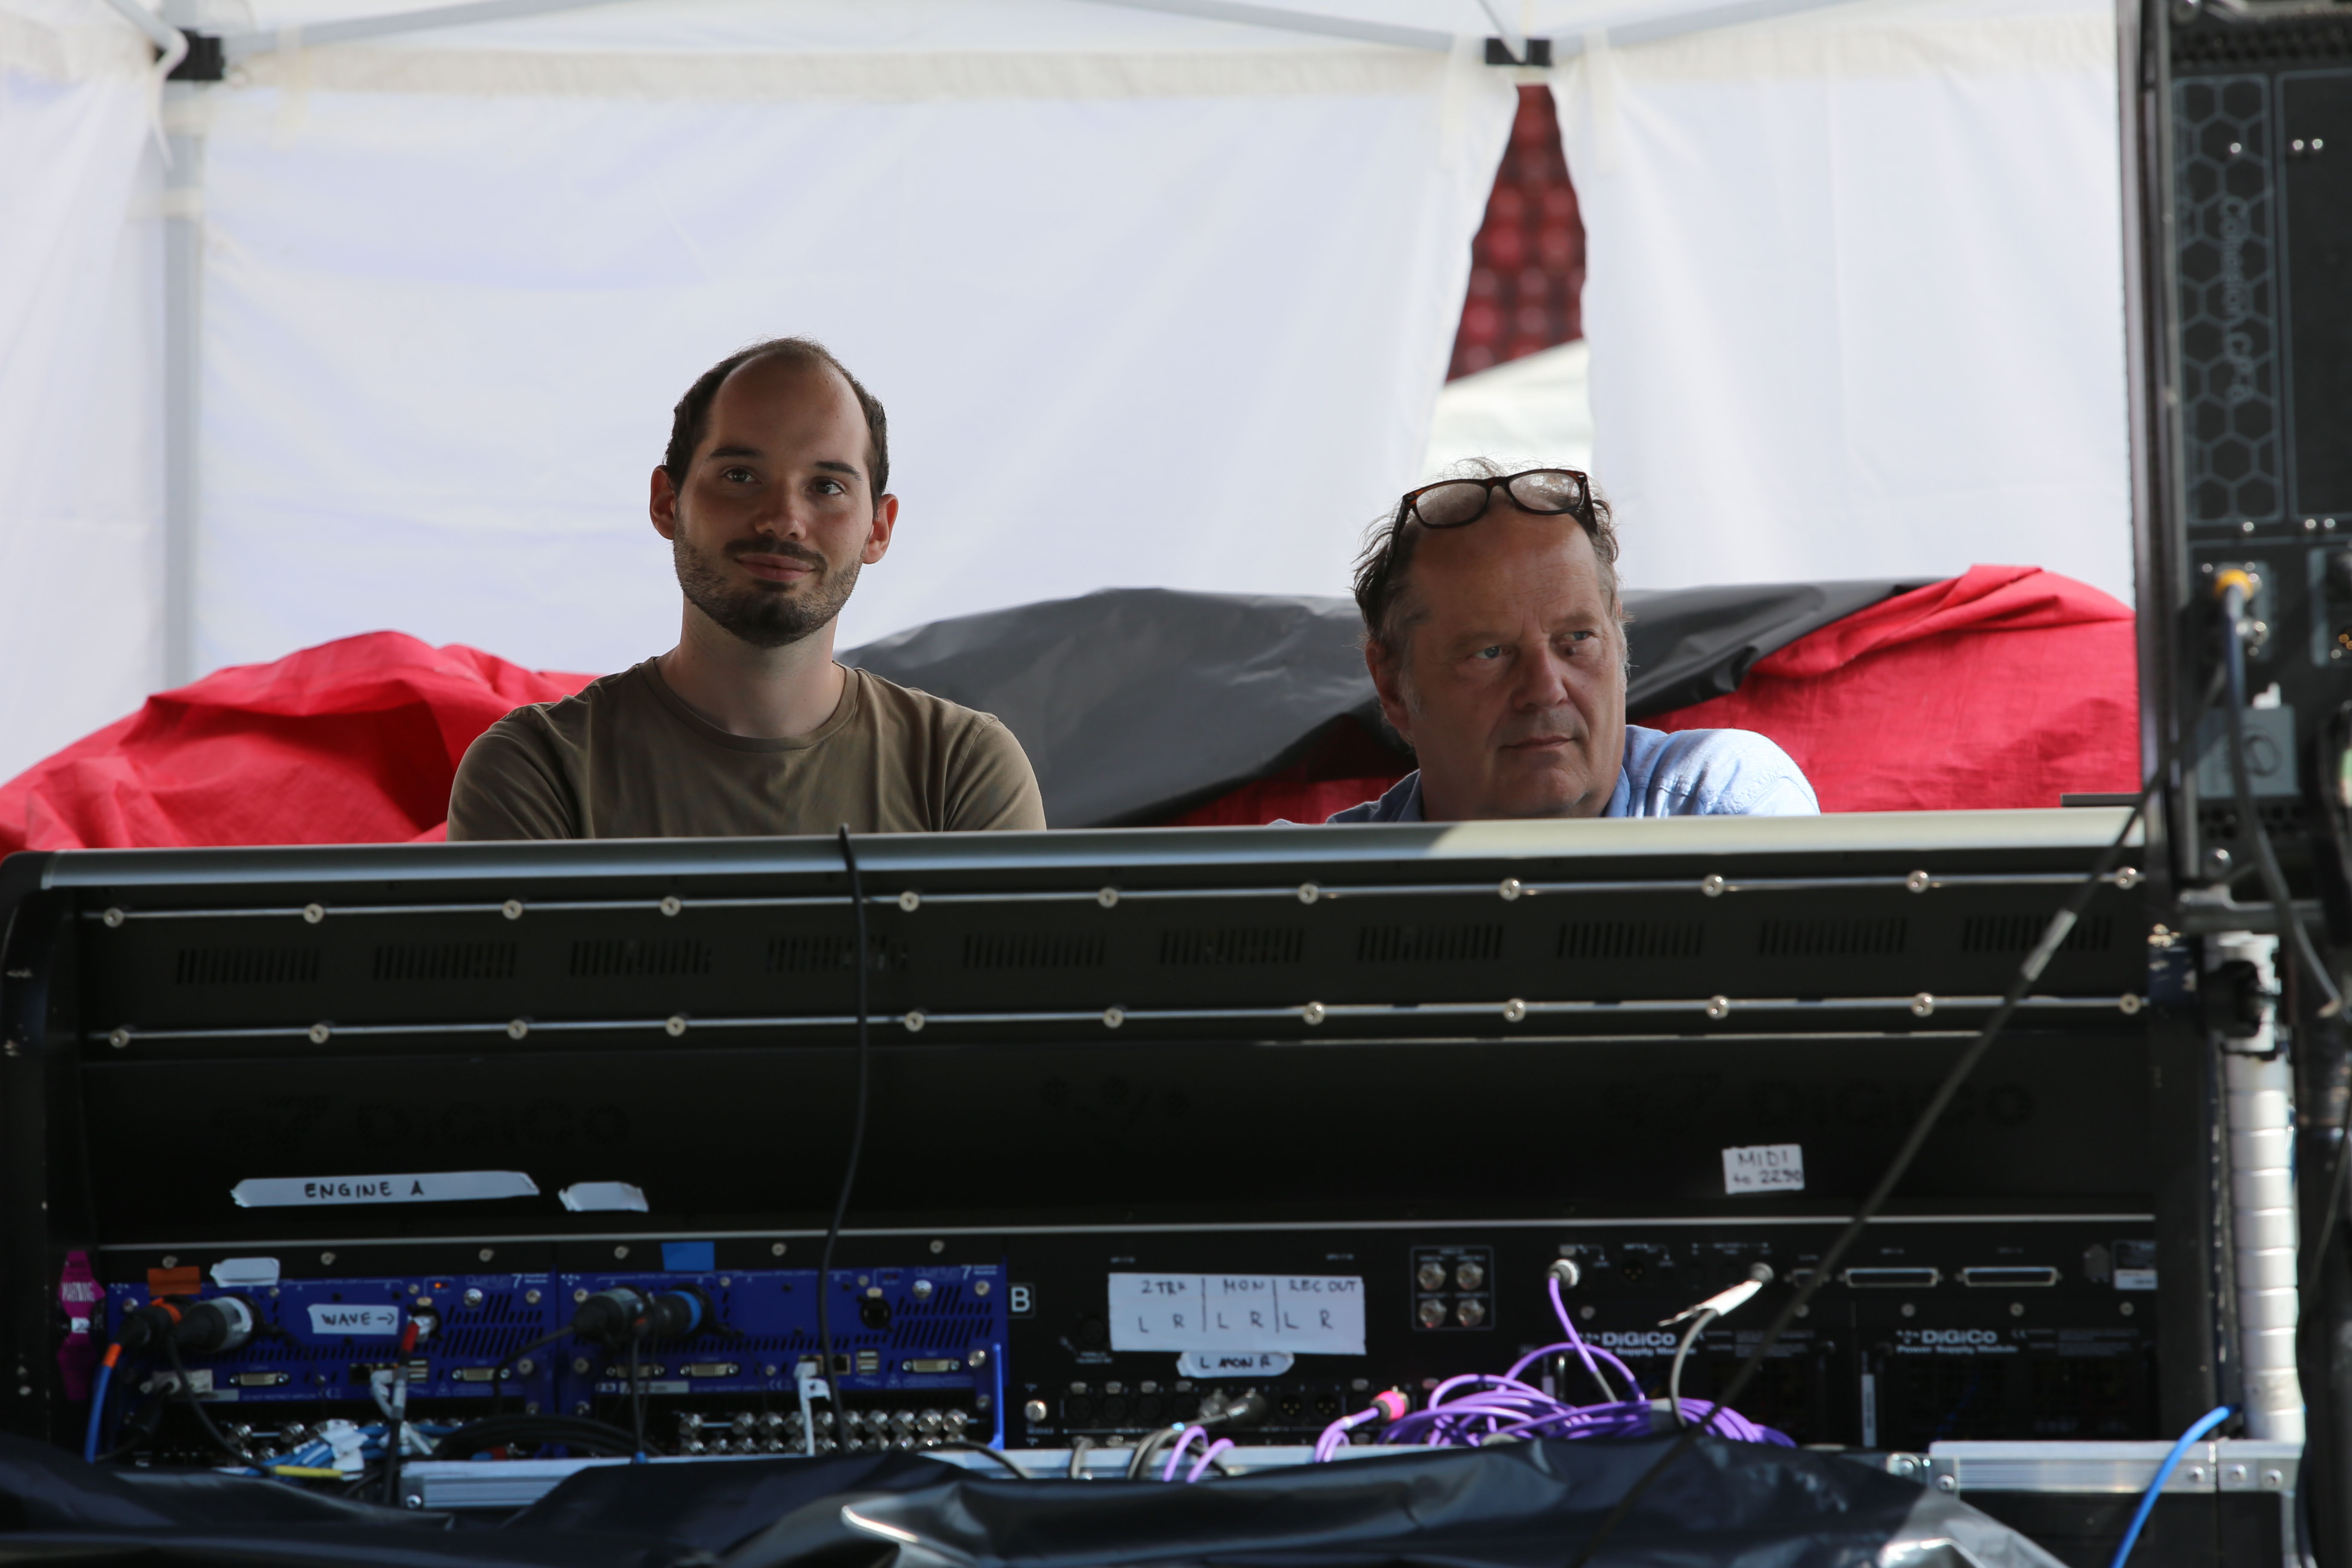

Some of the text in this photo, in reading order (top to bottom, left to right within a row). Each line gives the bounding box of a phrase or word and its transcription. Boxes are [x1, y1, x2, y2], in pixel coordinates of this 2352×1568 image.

[1738, 1150, 1788, 1166] MIDI
[305, 1181, 424, 1198] ENGINE A
[961, 1265, 972, 1280] 7
[511, 1273, 523, 1288] 7
[1142, 1279, 1153, 1294] 2
[1223, 1278, 1264, 1295] MON
[1289, 1279, 1323, 1293] REC
[1328, 1280, 1358, 1292] OUT
[1010, 1286, 1031, 1312] B
[321, 1312, 371, 1326] WAVE
[1138, 1309, 1333, 1333] L R L R L R
[1602, 1331, 1676, 1346] DiGiCo
[1921, 1329, 1997, 1344] DiGiCo
[1200, 1356, 1210, 1369] L
